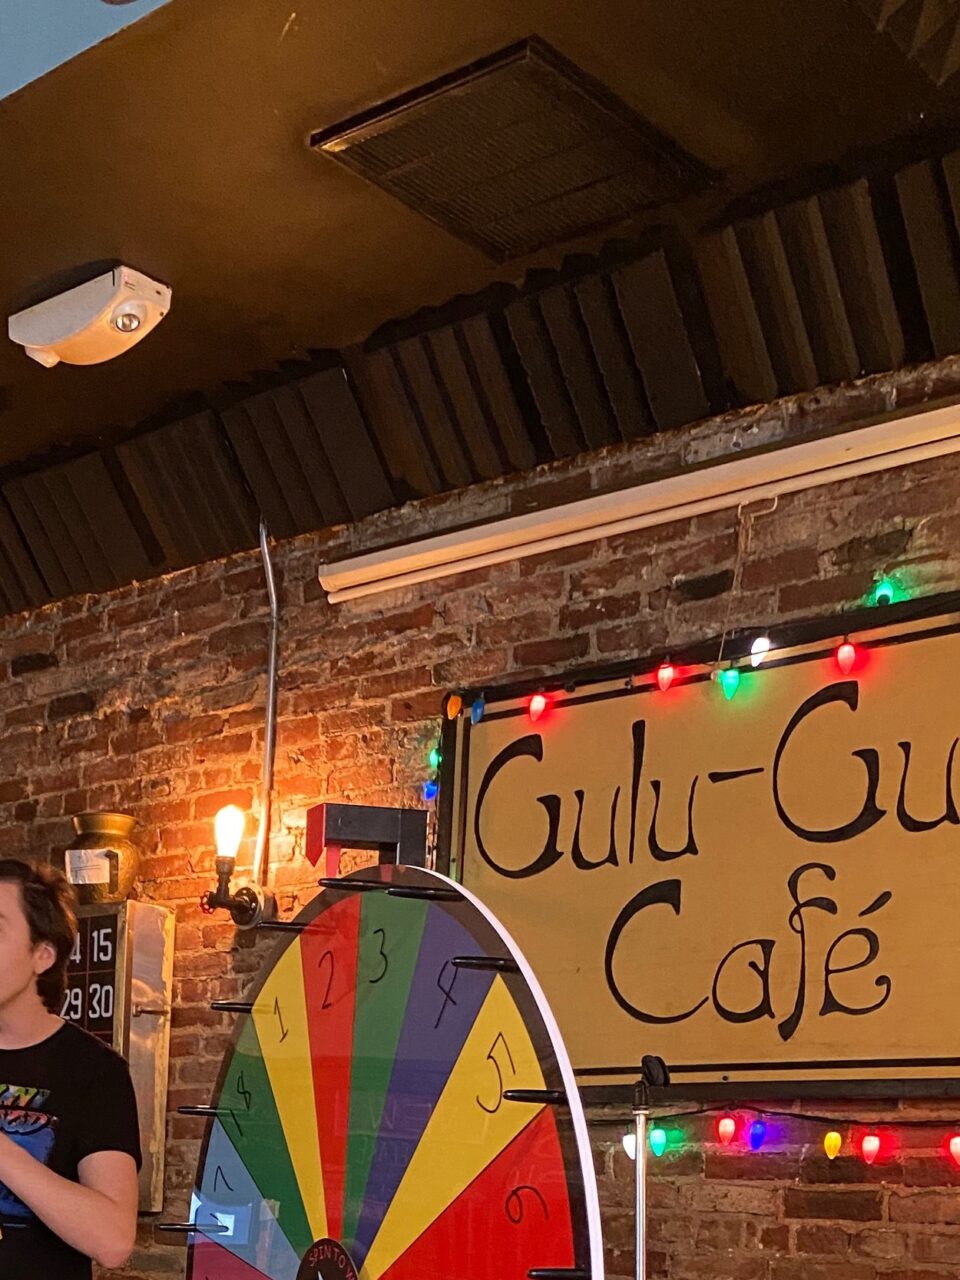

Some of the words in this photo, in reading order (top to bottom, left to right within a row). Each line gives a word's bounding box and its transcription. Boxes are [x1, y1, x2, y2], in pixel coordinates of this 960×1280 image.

[69, 931, 82, 964] 4
[91, 927, 113, 962] 15
[368, 928, 390, 984] 3
[604, 861, 892, 1042] Café
[59, 987, 83, 1020] 29
[88, 983, 114, 1019] 30
[318, 950, 336, 1010] 2
[434, 960, 461, 1029] 4
[476, 1031, 516, 1113] 5
[308, 1245, 332, 1267] SPIN
[332, 1248, 346, 1269] TO
